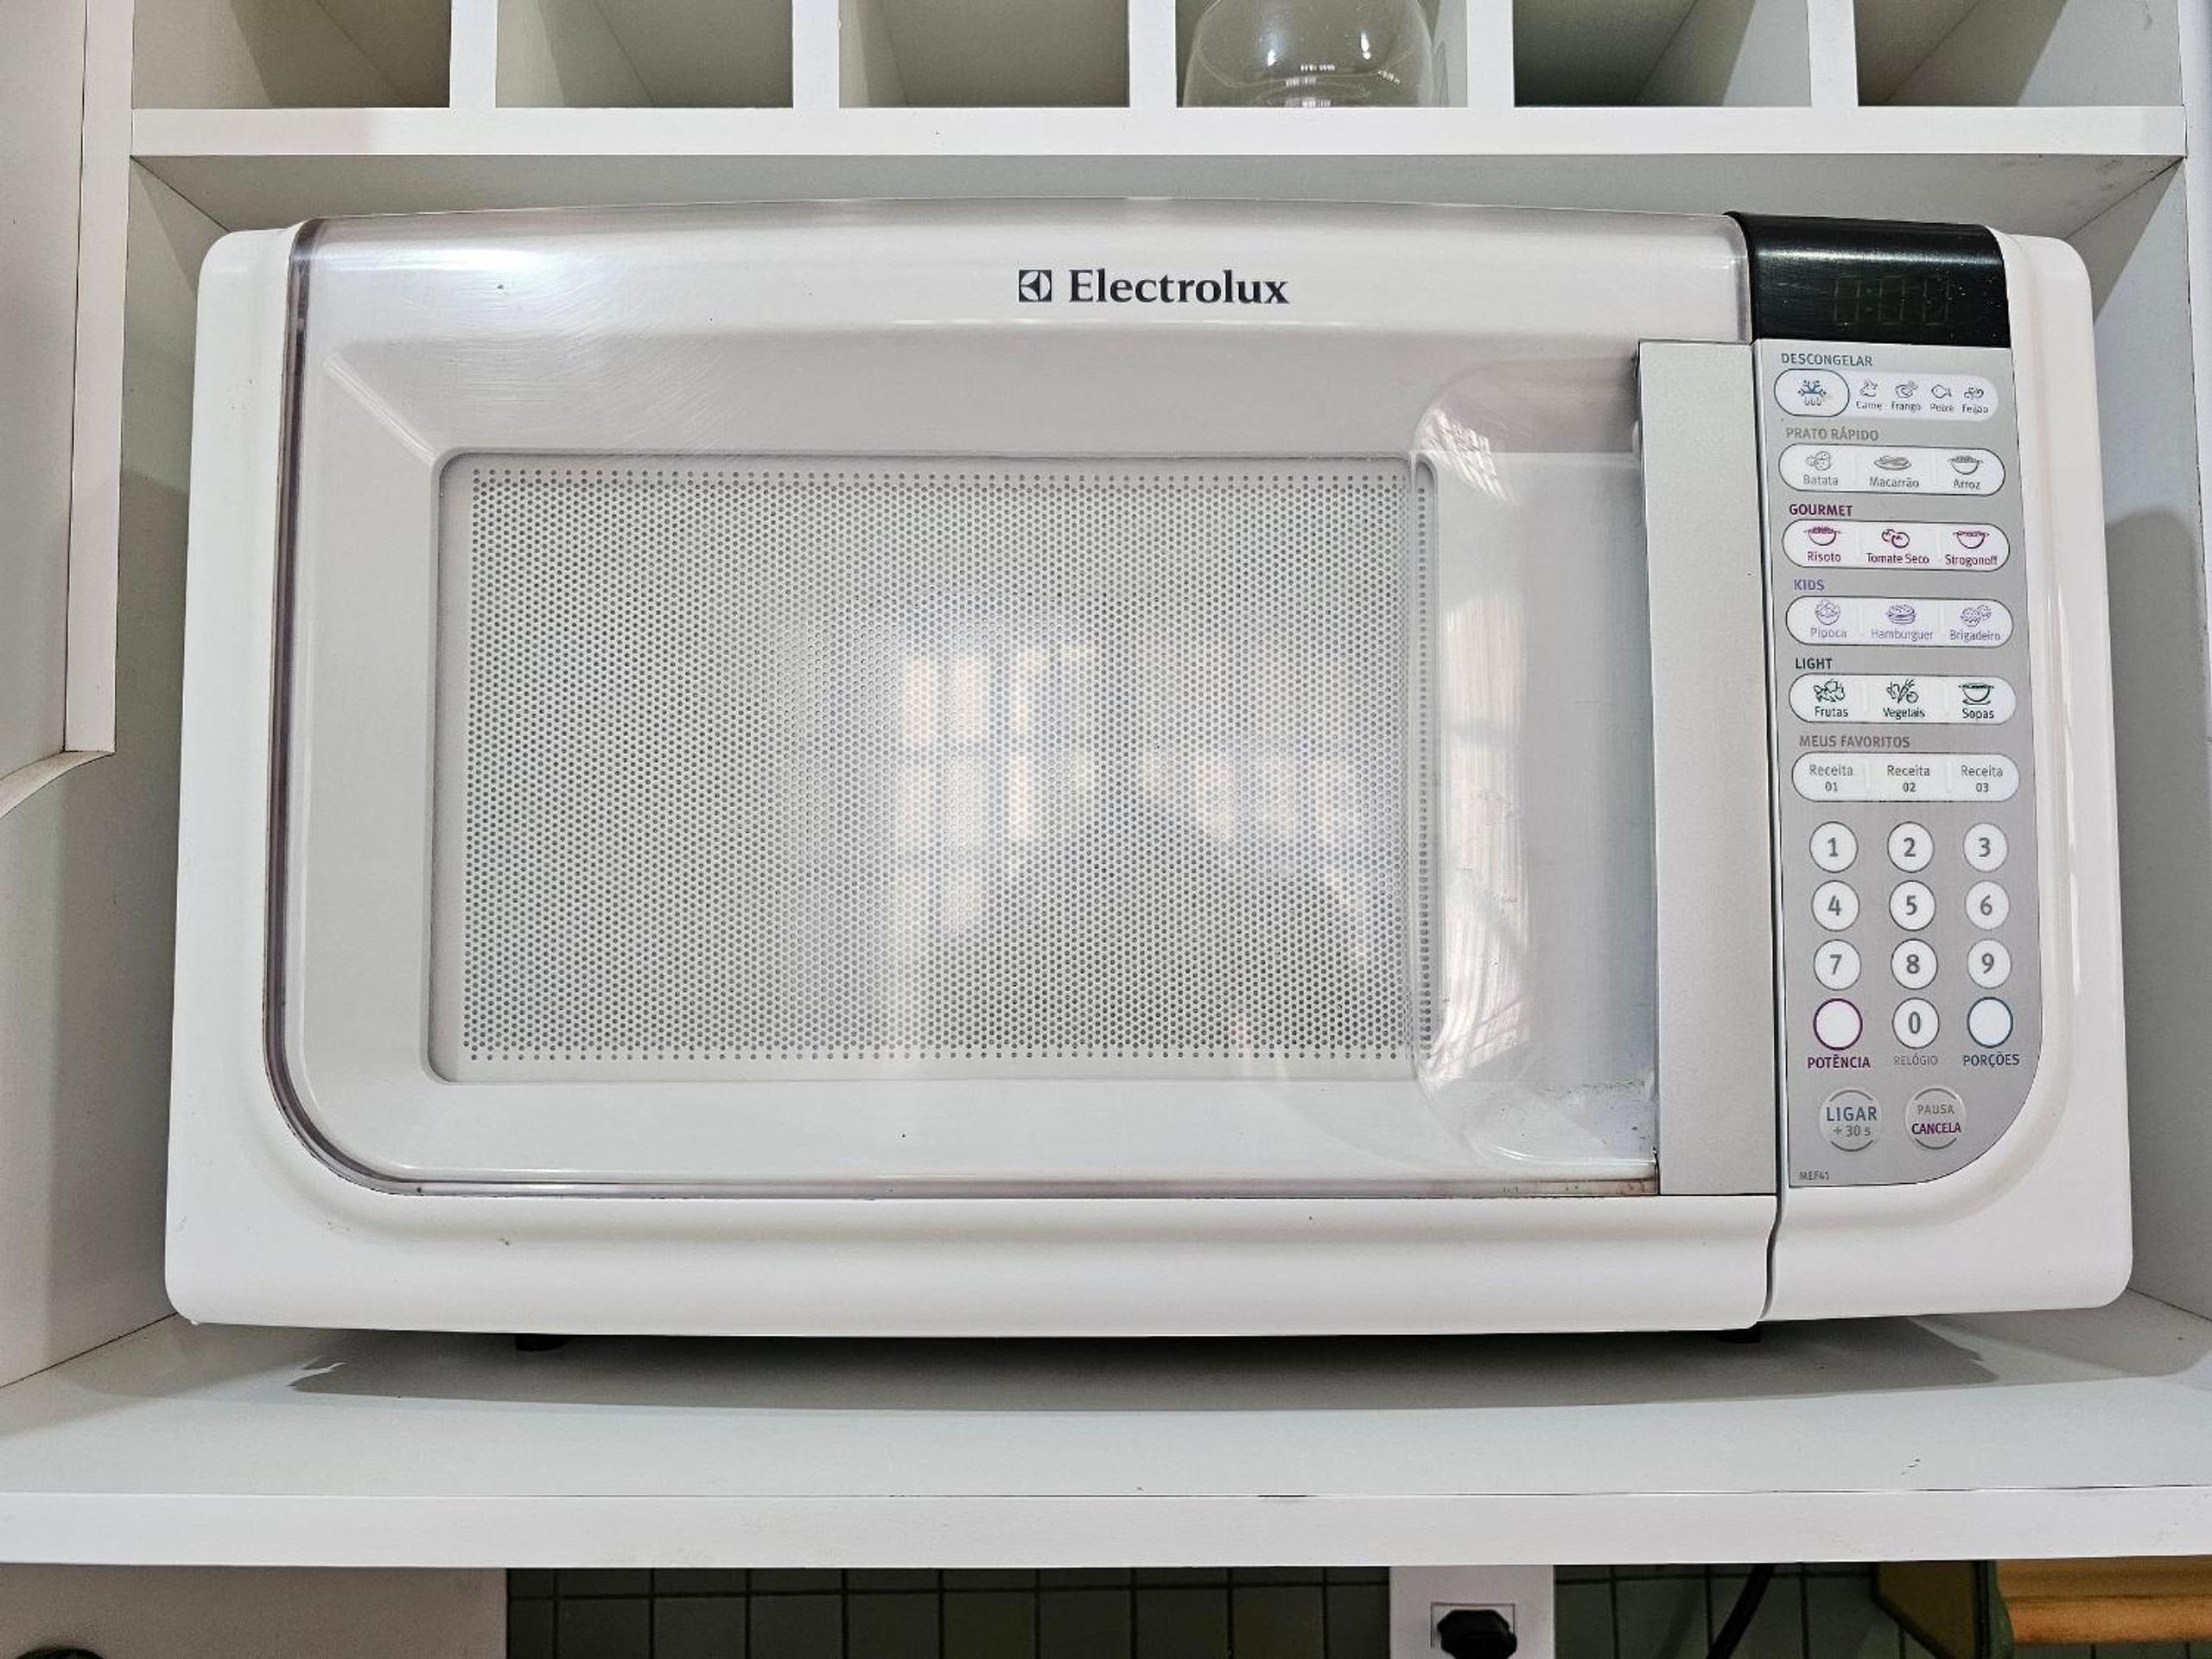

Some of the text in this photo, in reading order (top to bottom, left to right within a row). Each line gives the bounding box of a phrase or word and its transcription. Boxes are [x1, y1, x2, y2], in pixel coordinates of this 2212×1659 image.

[1068, 268, 1291, 304] Electrolux
[1781, 353, 1873, 366] DESCONGELAR
[1891, 400, 1922, 411] Frango
[1786, 426, 1878, 441] PRATO RÁPIDO
[1803, 475, 1839, 486] Batata
[1869, 477, 1920, 488] Macarrão
[1954, 478, 1980, 490] Arroz
[1789, 504, 1853, 517] GOURMET
[1807, 551, 1841, 563] Risoto
[1866, 553, 1929, 564] Tomate Seco
[1945, 554, 1998, 567] Strogonoff
[1794, 579, 1825, 591] KIDS
[1810, 628, 1847, 639] Pipoca
[1871, 628, 1934, 642] Hamburguer
[1950, 629, 2000, 642] Brigadeiro
[1796, 658, 1833, 670] LIGHT
[1815, 706, 1848, 718] Frutas
[1883, 708, 1925, 720] Vegetais
[1962, 709, 1994, 720] Sopas
[1799, 735, 1910, 748] MEUS FAVORITOS
[1809, 764, 1853, 776] Receita
[1887, 765, 1930, 777] Receita
[1961, 766, 2003, 778] Receita
[1825, 782, 1839, 792] 01
[1903, 782, 1916, 793] 02
[1975, 782, 1989, 793] 03
[1827, 837, 1839, 858] 1
[1903, 837, 1916, 858] 2
[1978, 837, 1991, 858] 3
[1827, 895, 1841, 916] 4
[1905, 895, 1918, 916] 5
[1980, 895, 1993, 916] 6
[1829, 954, 1842, 976] 7
[1905, 954, 1920, 975] 8
[1981, 953, 1994, 974] 9
[1908, 1011, 1922, 1034] 0
[1808, 1054, 1871, 1069] POTÊNCIA
[1894, 1052, 1938, 1065] RELÓGIO
[1963, 1052, 2020, 1068] PORÇÕES
[1826, 1107, 1878, 1122] LIGAR
[1917, 1104, 1955, 1116] PAUSA
[1846, 1125, 1860, 1137] 30
[1911, 1122, 1961, 1135] CANCELA
[1798, 1171, 1830, 1180] MEF41
